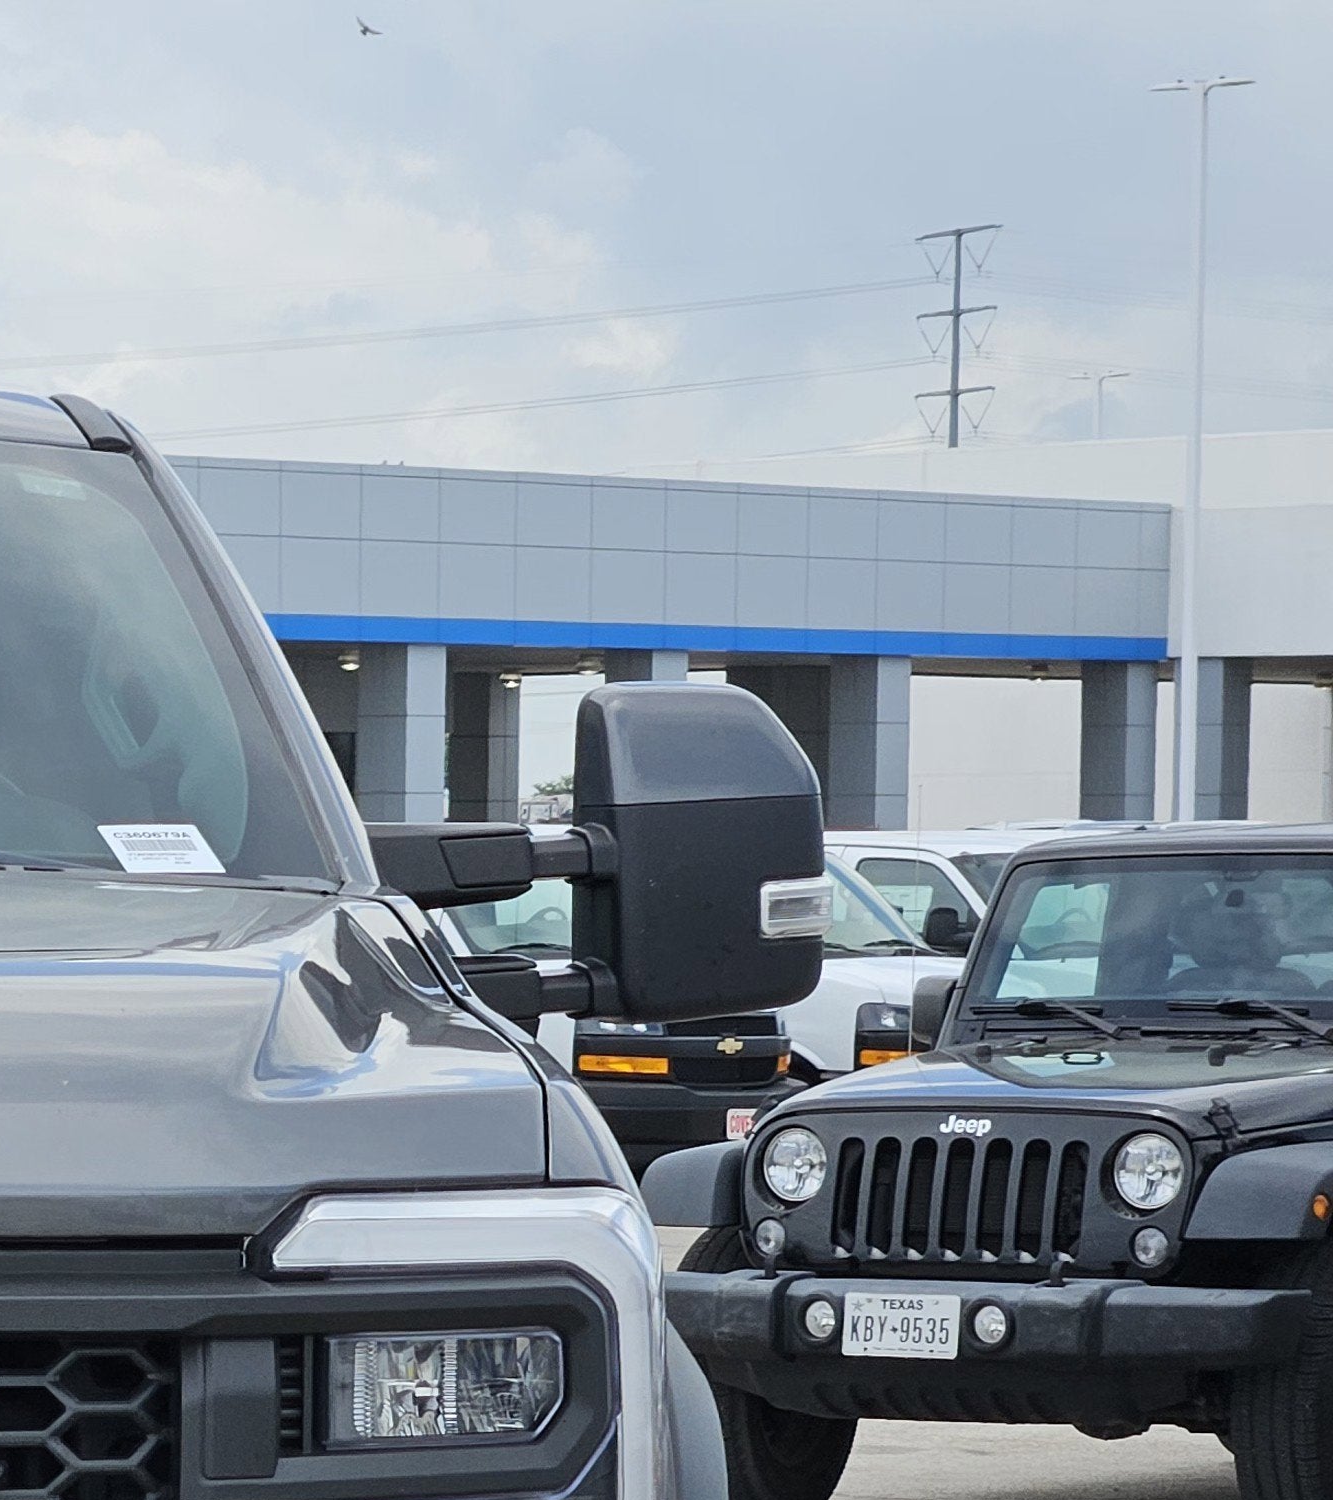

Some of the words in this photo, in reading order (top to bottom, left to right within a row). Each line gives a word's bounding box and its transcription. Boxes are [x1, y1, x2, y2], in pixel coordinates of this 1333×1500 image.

[730, 1114, 754, 1133] COVE
[939, 1114, 992, 1137] Jeep
[880, 1299, 924, 1310] TEXAS
